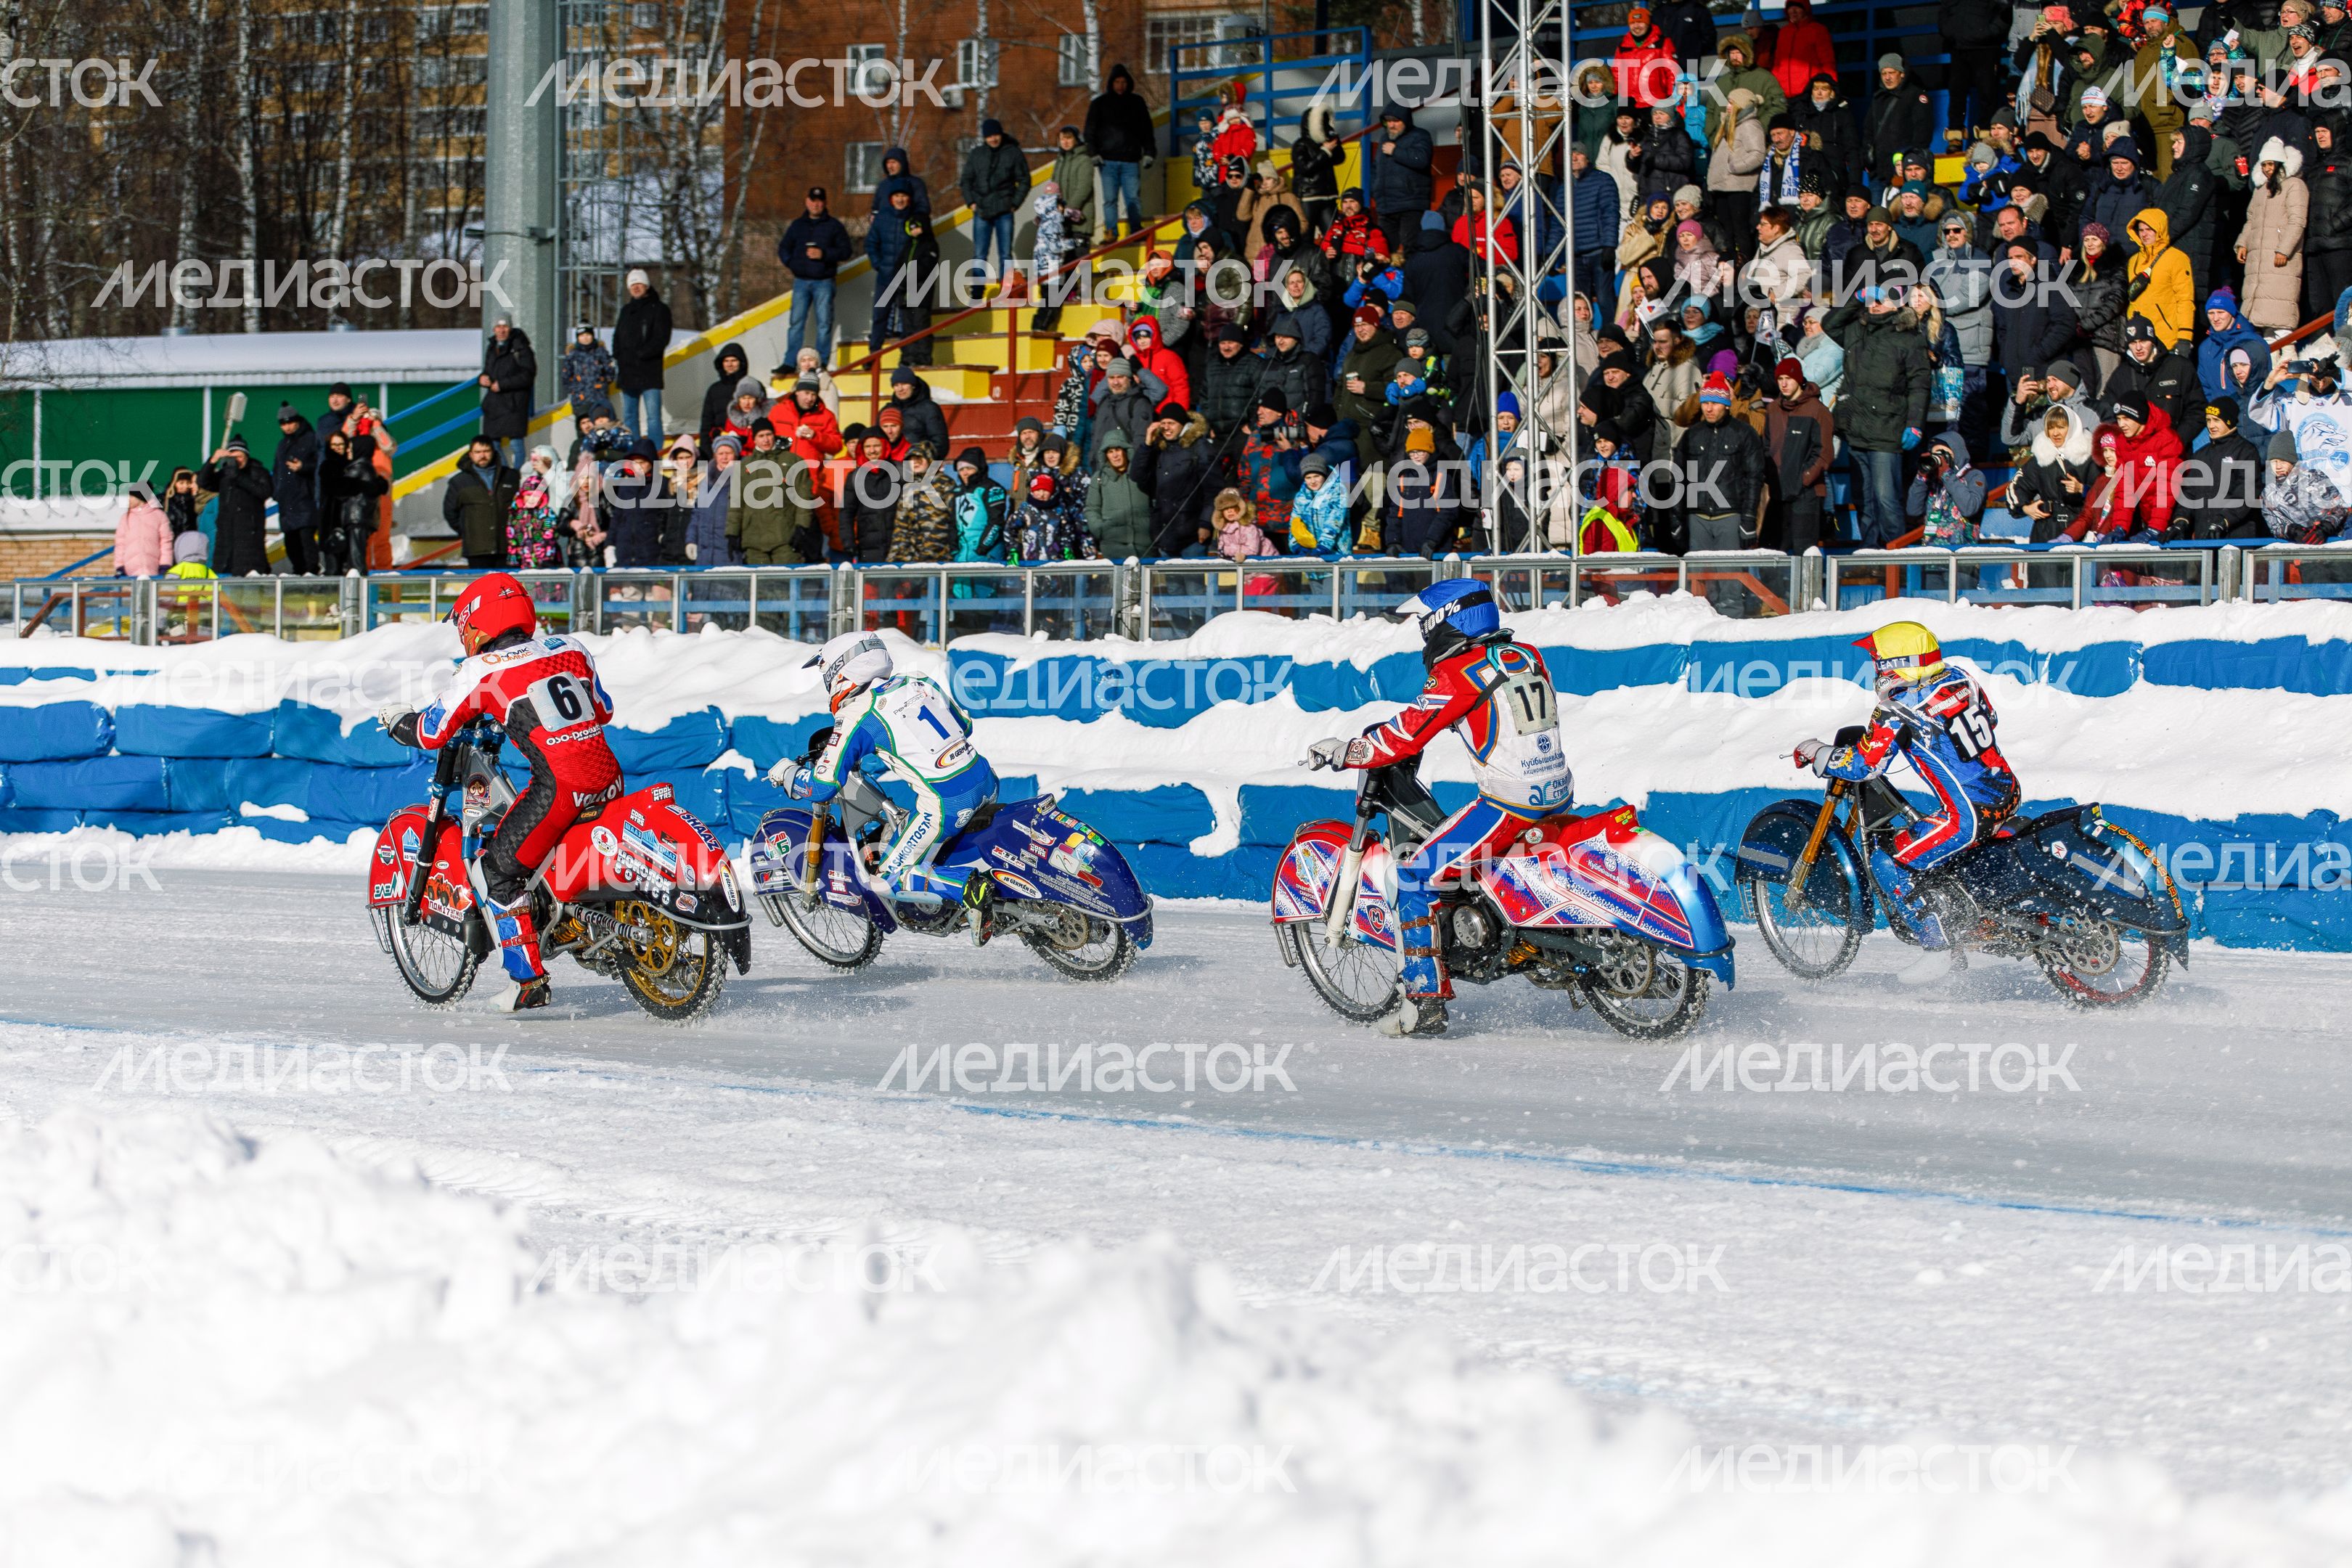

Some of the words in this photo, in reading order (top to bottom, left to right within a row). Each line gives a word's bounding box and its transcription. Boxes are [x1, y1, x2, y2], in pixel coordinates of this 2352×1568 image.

[1423, 599, 1461, 634] 100%
[1876, 658, 1906, 671] LEATT
[546, 675, 582, 721] 6
[1514, 681, 1546, 722] 17
[917, 704, 951, 740] 1
[1949, 704, 1993, 758] 15
[572, 774, 623, 808] VOLKOV
[653, 785, 672, 796] COOL
[653, 791, 673, 802] MTRS
[629, 814, 645, 827] MTRS
[631, 808, 645, 821] COOL
[680, 813, 722, 852] SHAAZ
[658, 845, 677, 862] SHAAZ
[1009, 877, 1031, 892] GERMAN
[1029, 888, 1038, 897] OIL
